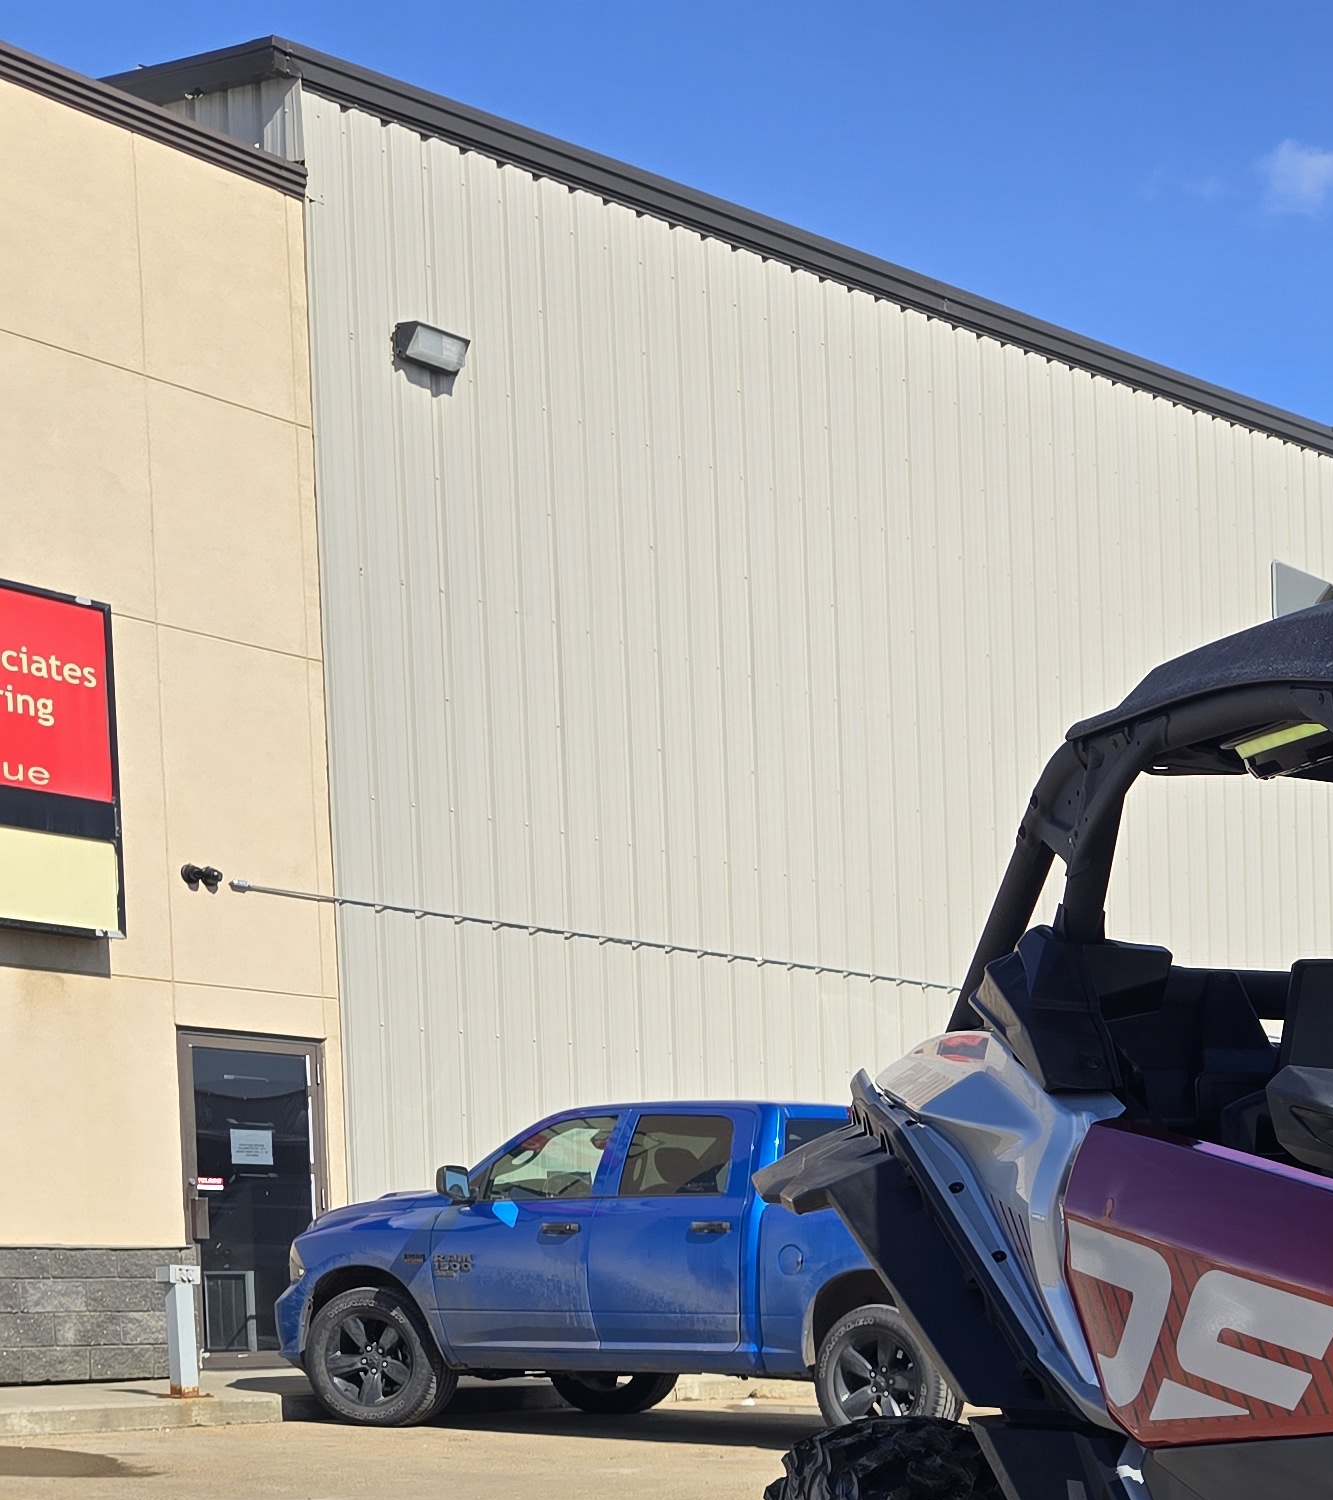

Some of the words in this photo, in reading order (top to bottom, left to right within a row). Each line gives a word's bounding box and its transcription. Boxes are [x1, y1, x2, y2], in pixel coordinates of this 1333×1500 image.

[0, 684, 55, 727] ing
[433, 1254, 472, 1262] RAM
[433, 1261, 473, 1272] 1500
